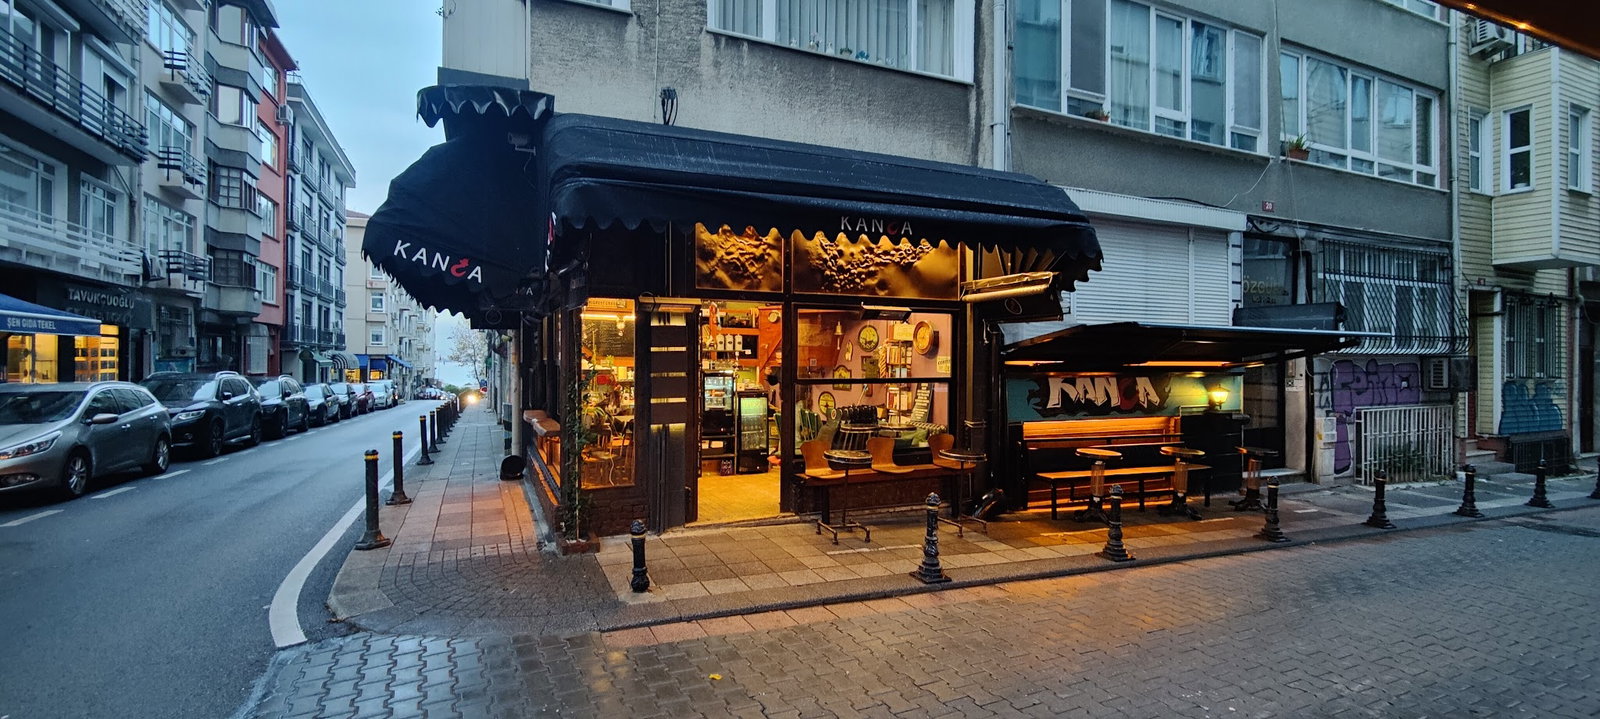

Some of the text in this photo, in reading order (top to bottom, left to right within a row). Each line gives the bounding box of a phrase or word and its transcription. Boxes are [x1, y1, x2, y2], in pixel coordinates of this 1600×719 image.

[1265, 202, 1273, 210] 20
[7, 317, 56, 330] ŞEN GIDA TEKEL
